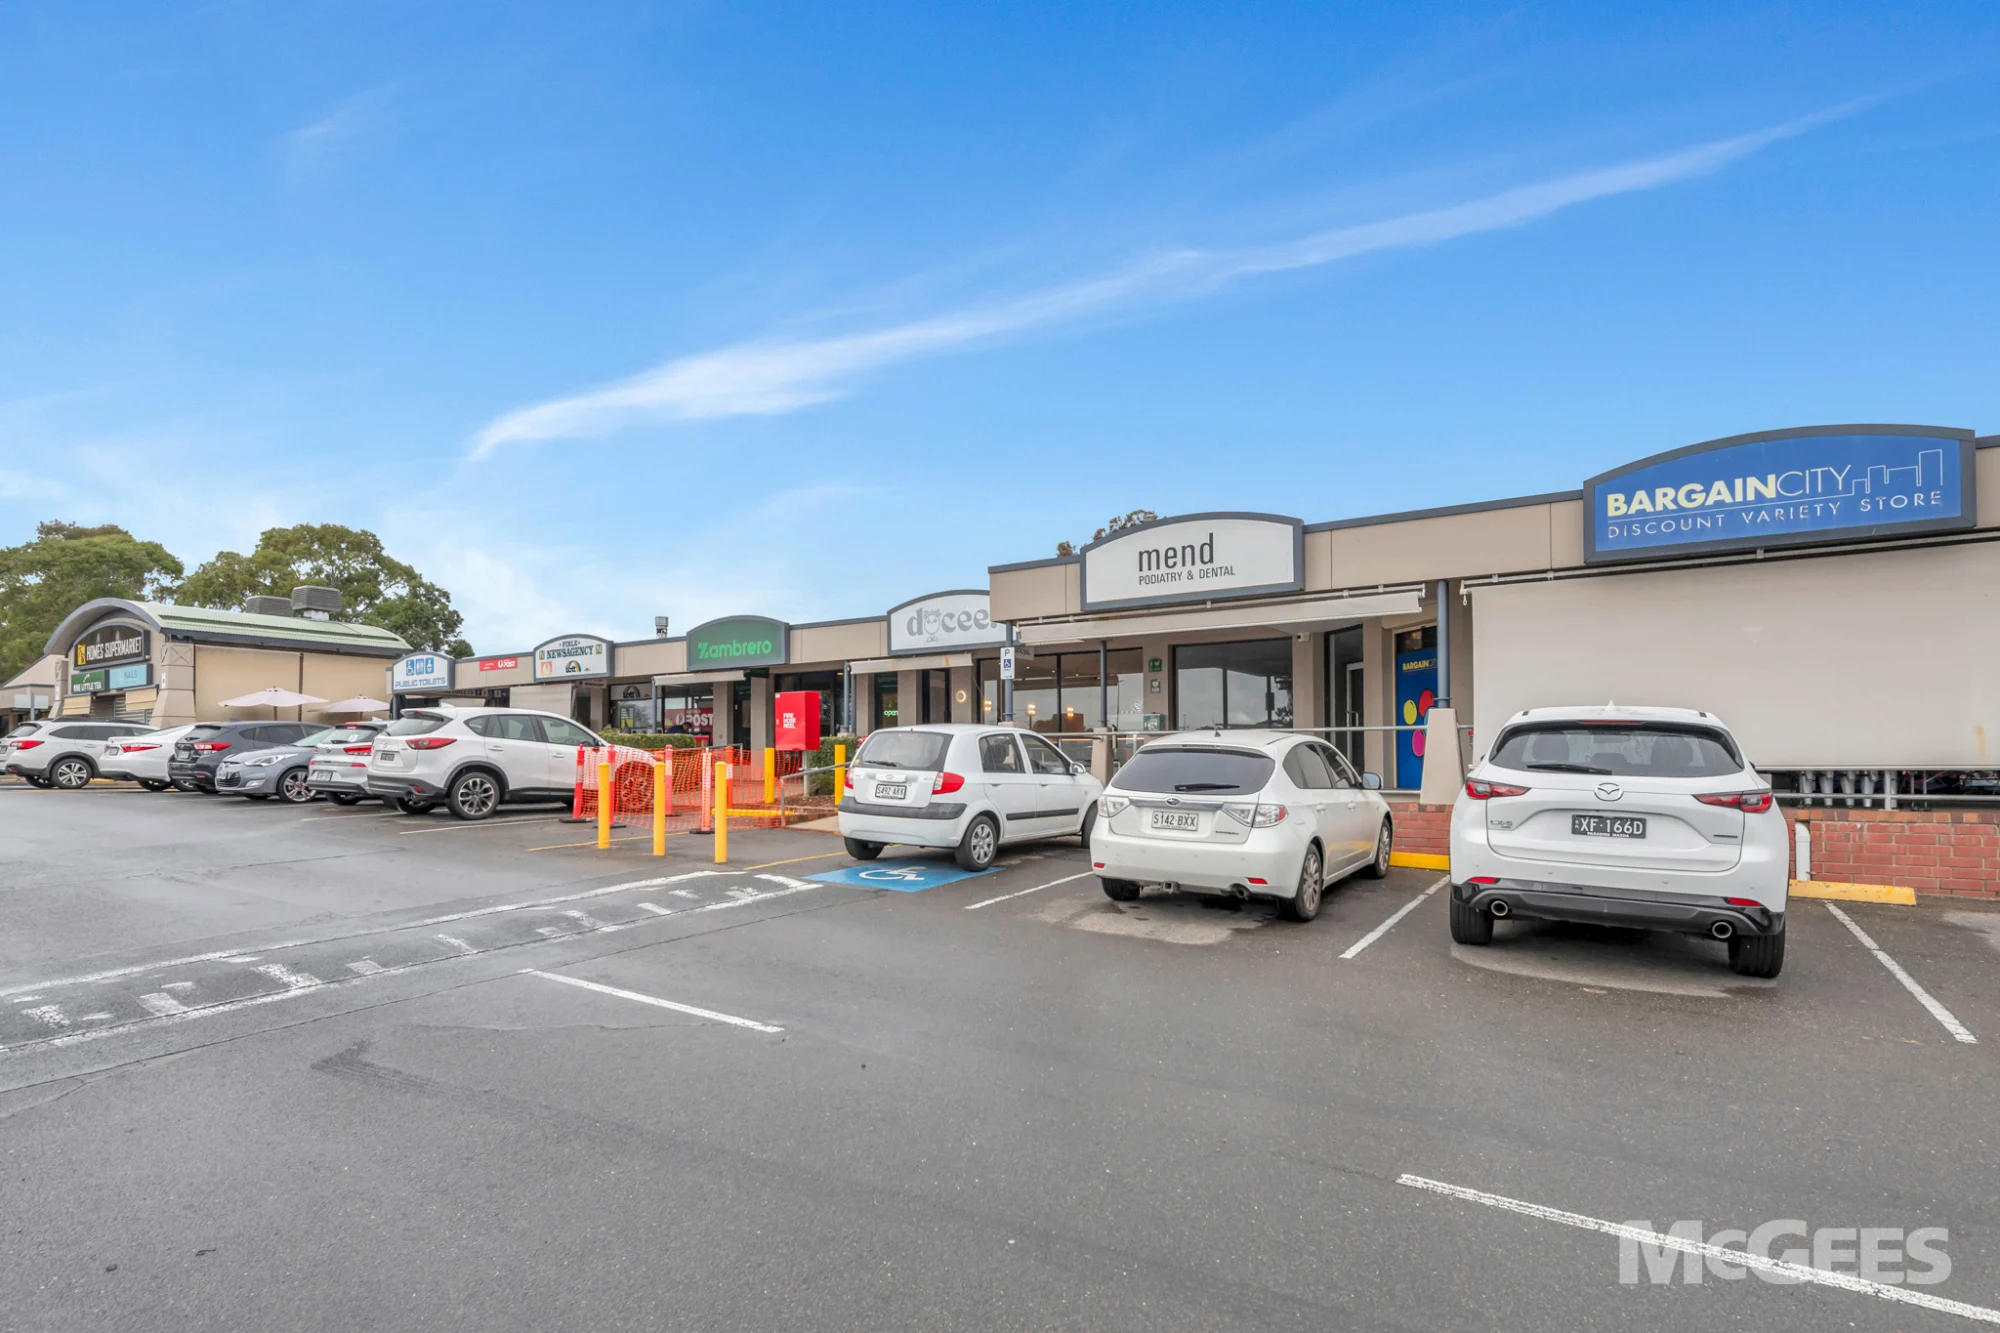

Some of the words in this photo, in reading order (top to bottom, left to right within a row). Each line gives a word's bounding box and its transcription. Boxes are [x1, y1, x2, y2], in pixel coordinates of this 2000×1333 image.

[1608, 514, 1725, 539] DISCOUNT
[1741, 501, 1841, 525] VARIETY
[1860, 490, 1943, 512] STORE
[1139, 532, 1214, 572] mend
[1139, 571, 1183, 586] PODIATRY
[1186, 570, 1195, 580] &
[1199, 565, 1236, 579] DENTAL
[86, 643, 104, 661] HOMES
[104, 637, 142, 657] SUPERMARKET
[546, 645, 594, 659] NEWSAGENCY
[698, 640, 772, 659] Zambrero
[1005, 649, 1010, 657] P
[73, 683, 81, 692] ONE
[80, 682, 94, 691] LITTLE
[395, 680, 418, 688] PUBLIC
[419, 677, 446, 686] TOILETS
